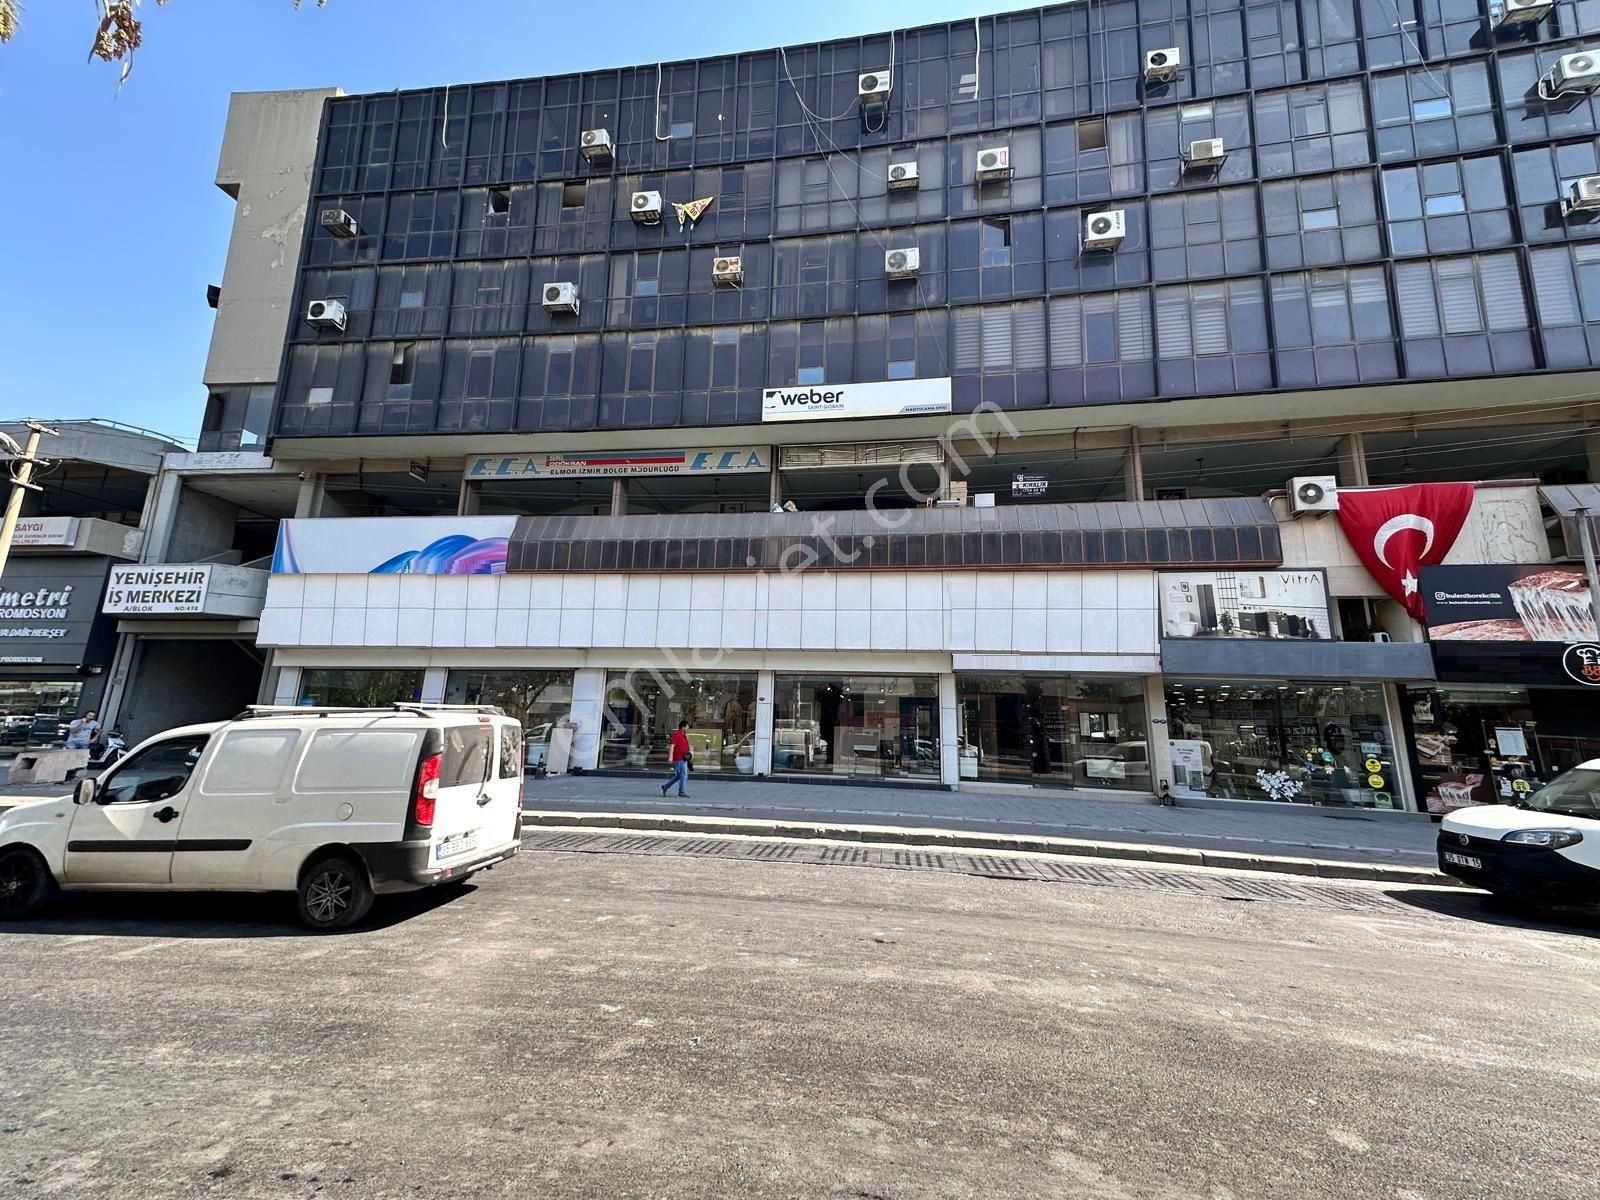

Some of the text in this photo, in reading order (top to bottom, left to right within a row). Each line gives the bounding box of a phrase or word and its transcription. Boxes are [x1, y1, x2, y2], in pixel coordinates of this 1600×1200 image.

[780, 388, 844, 406] weber
[115, 568, 206, 588] YENİŞEHİR
[108, 586, 203, 607] İŞ MERKEZİ
